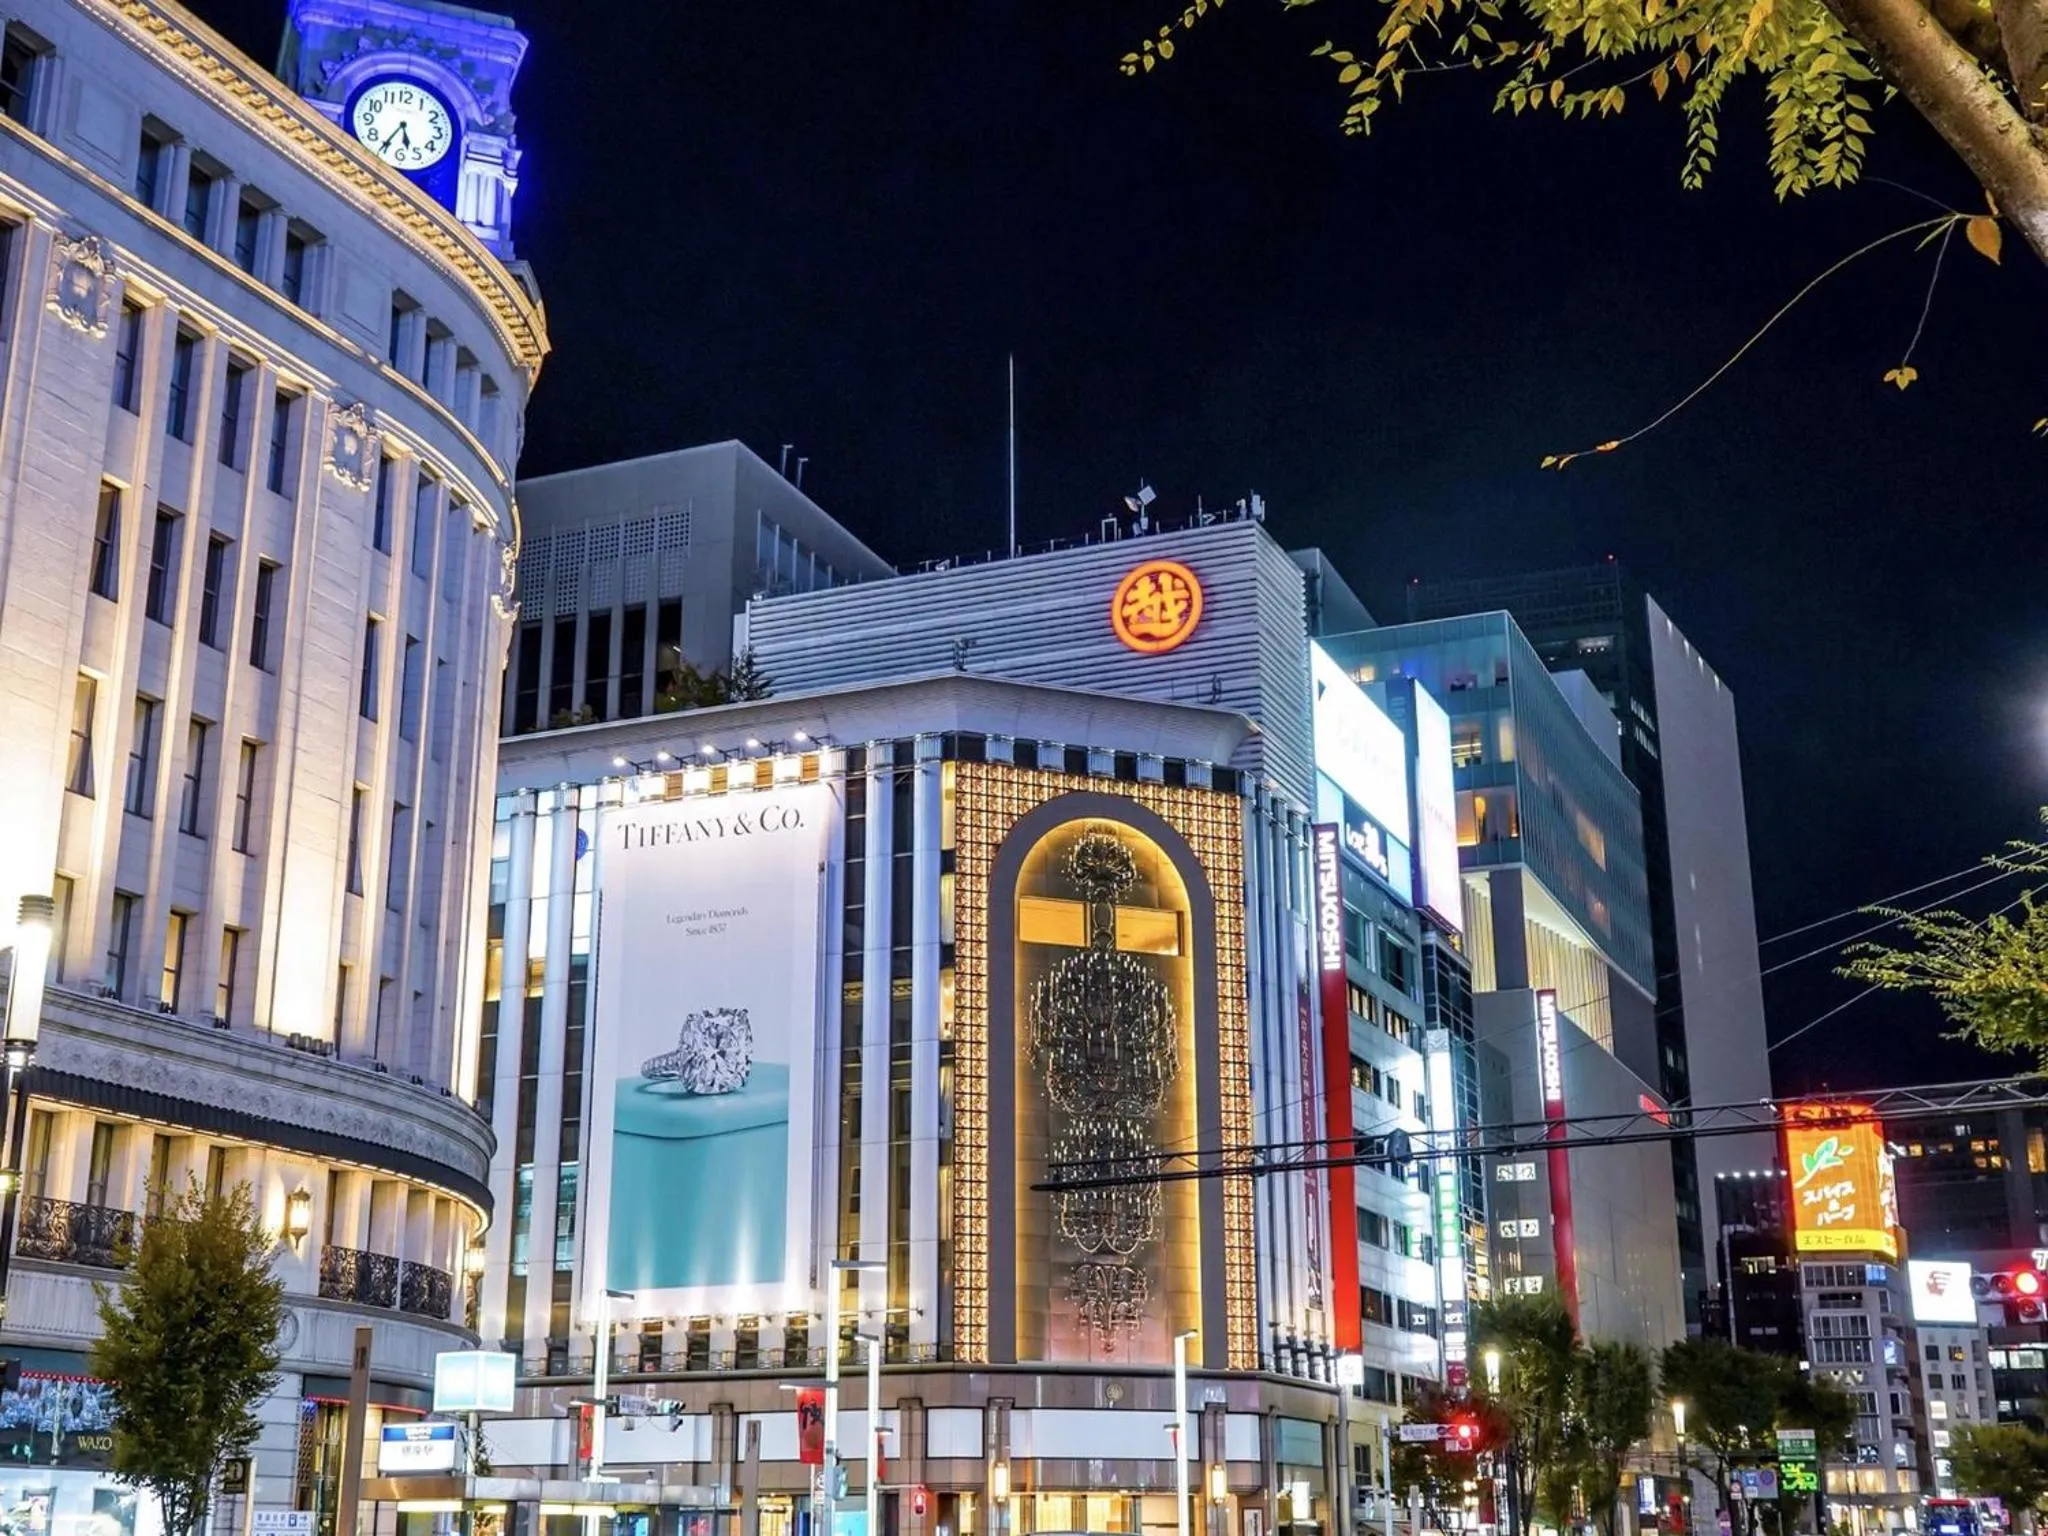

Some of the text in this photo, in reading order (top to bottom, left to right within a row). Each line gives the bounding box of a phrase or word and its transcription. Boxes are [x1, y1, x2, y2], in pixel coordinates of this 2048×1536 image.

[384, 90, 395, 104] 11
[399, 89, 414, 104] 12
[369, 98, 382, 113] 10
[419, 98, 424, 111] 1
[363, 113, 374, 126] 9
[428, 110, 439, 124] 2
[367, 128, 378, 142] 8
[432, 126, 443, 140] 3
[424, 140, 436, 153] 4
[395, 148, 406, 162] 6
[411, 147, 422, 161] 5
[617, 816, 730, 850] TIFFANY
[733, 812, 753, 836] &
[1318, 830, 1342, 971] MITSUKOSHI
[1540, 994, 1562, 1101] MITSUKOSHI
[77, 1434, 113, 1451] WAKO
